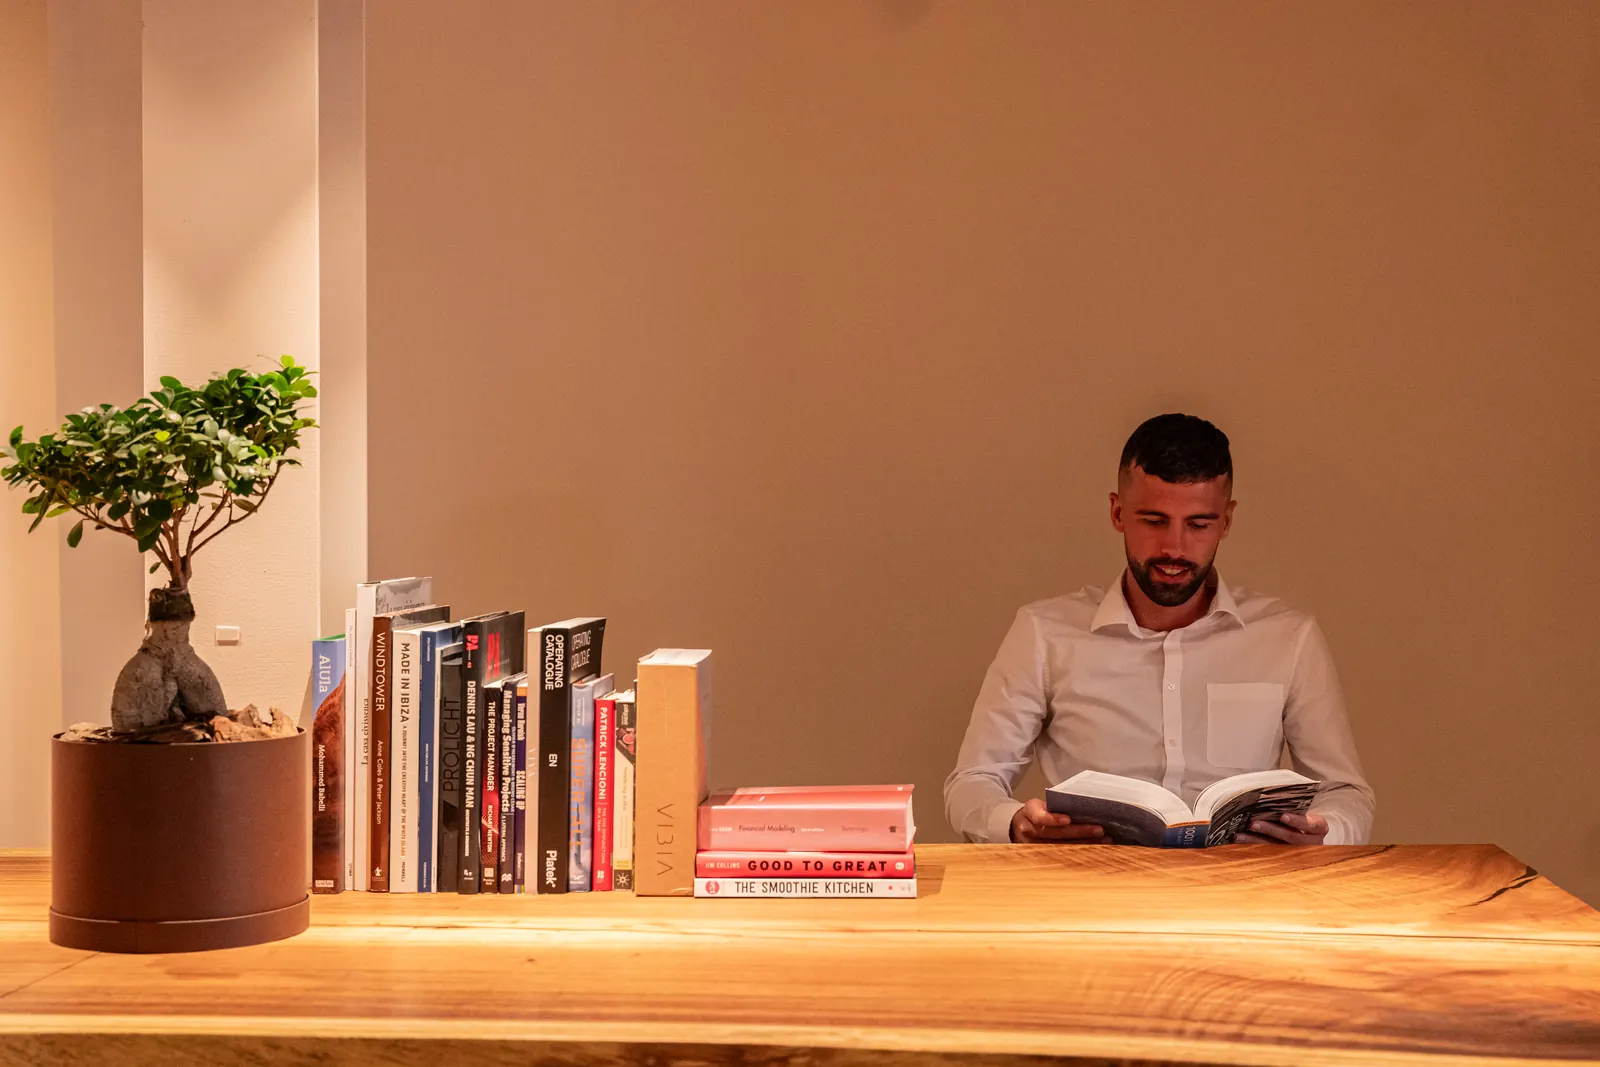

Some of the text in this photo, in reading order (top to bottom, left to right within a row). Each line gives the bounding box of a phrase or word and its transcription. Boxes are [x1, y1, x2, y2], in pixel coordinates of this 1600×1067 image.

[319, 654, 331, 693] AlUla
[376, 632, 385, 711] WINDTOWER
[545, 634, 555, 690] CATALOGUE
[555, 634, 564, 688] OPERATING
[400, 643, 410, 723] MADE IN IBIZA
[466, 681, 476, 714] DENNIS
[443, 697, 460, 792] PROLICHT
[466, 716, 476, 734] LAU
[466, 744, 476, 758] NG
[487, 702, 495, 791] THE PROJECT MANAGER
[501, 690, 512, 812] Managing Sensitive Projects
[549, 753, 557, 767] EN
[599, 707, 607, 799] PATRICK LENCIONI
[466, 760, 476, 787] CHUN
[516, 770, 526, 810] SCALING UP
[466, 789, 476, 808] MAN
[570, 737, 585, 851] SUPERTALL
[657, 804, 674, 876] VIBIA
[738, 824, 765, 832] Financial
[767, 824, 795, 833] Modeling
[748, 861, 887, 871] GOOD TO GREAT
[735, 882, 874, 894] THE SMOOTHIE KITCHEN
